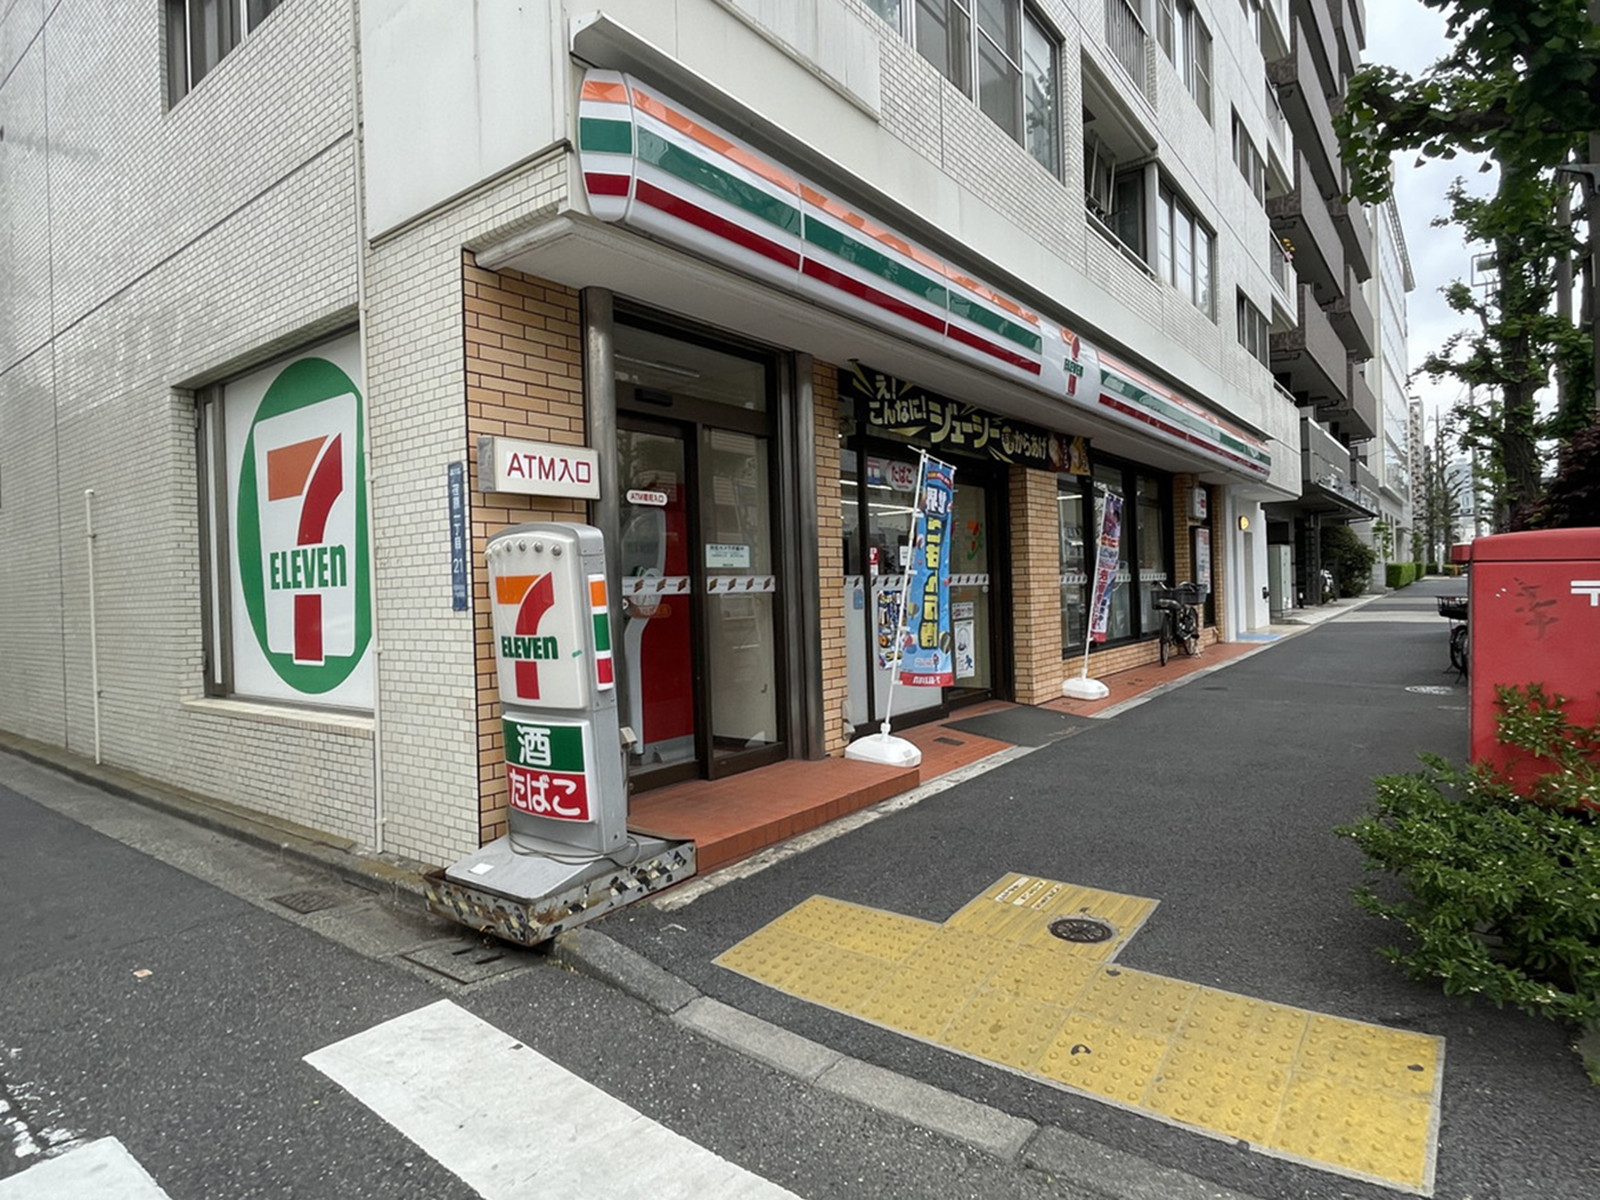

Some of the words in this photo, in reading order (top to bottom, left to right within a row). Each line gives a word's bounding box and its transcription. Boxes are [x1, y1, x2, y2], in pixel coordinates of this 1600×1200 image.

[869, 395, 927, 425] こんなに!
[928, 402, 1000, 449] ジューシー
[507, 452, 591, 483] ATM入口
[267, 432, 343, 661] 7
[453, 558, 464, 574] 21
[495, 571, 555, 700] 7
[516, 724, 552, 767] 酒
[509, 768, 582, 817] たばこ
